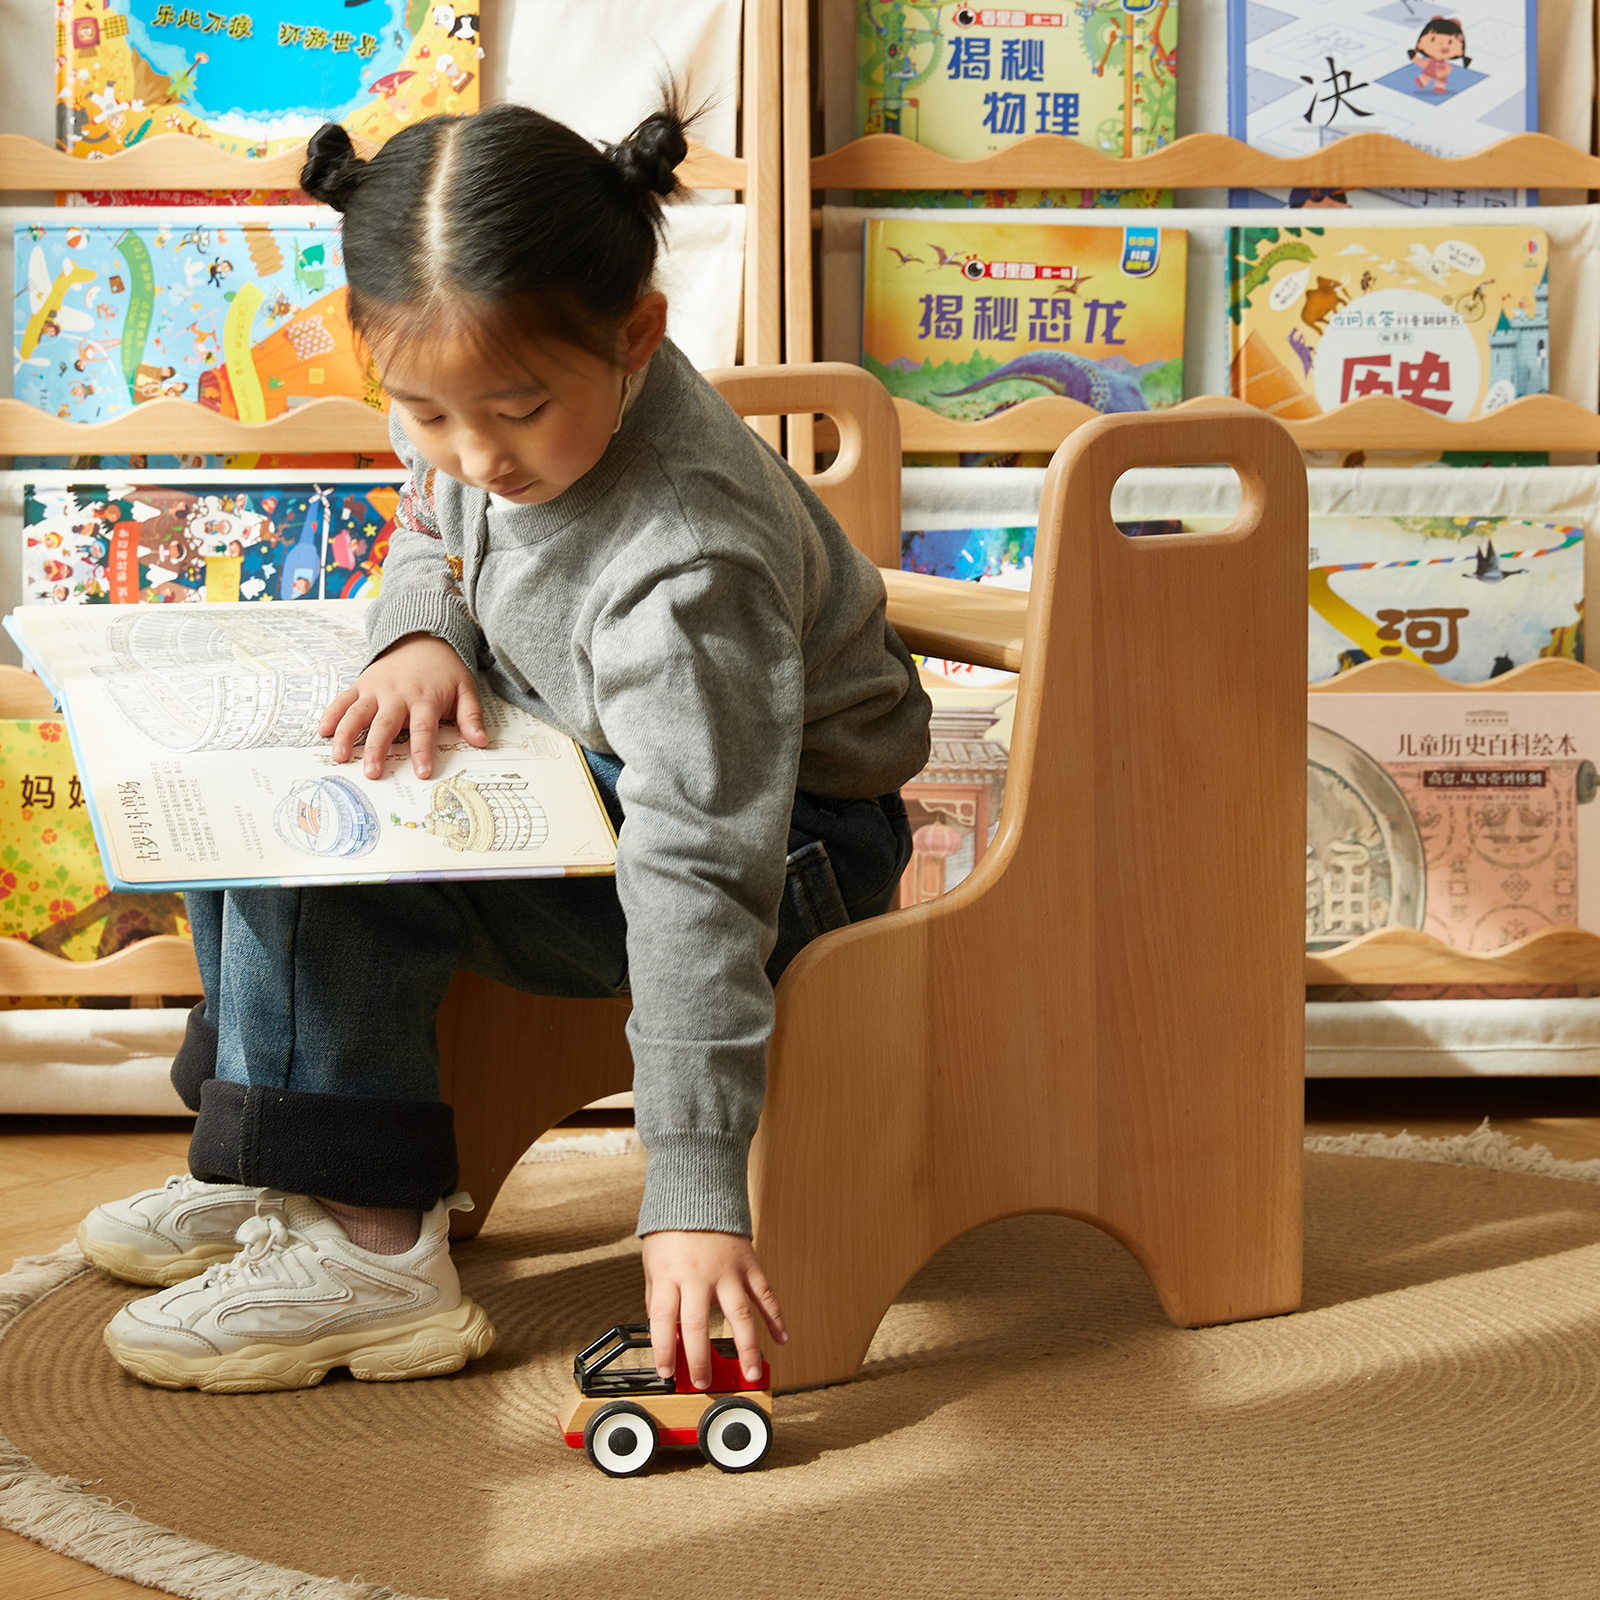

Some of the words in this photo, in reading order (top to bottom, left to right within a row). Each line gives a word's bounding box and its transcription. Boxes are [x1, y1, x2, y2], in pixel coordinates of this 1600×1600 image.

[151, 4, 253, 39] 乐此不疲
[278, 21, 379, 57] 环游世界
[947, 36, 1044, 82] 揭秘
[982, 91, 1080, 136] 物理
[1300, 56, 1375, 128] 决
[989, 261, 1037, 280] 看里面
[918, 293, 1128, 346] 揭秘恐龙
[1340, 350, 1454, 416] 历史
[1376, 608, 1469, 664] 河
[1395, 733, 1578, 757] 儿童历史百科绘本
[117, 779, 162, 865] 古罗马斗兽场
